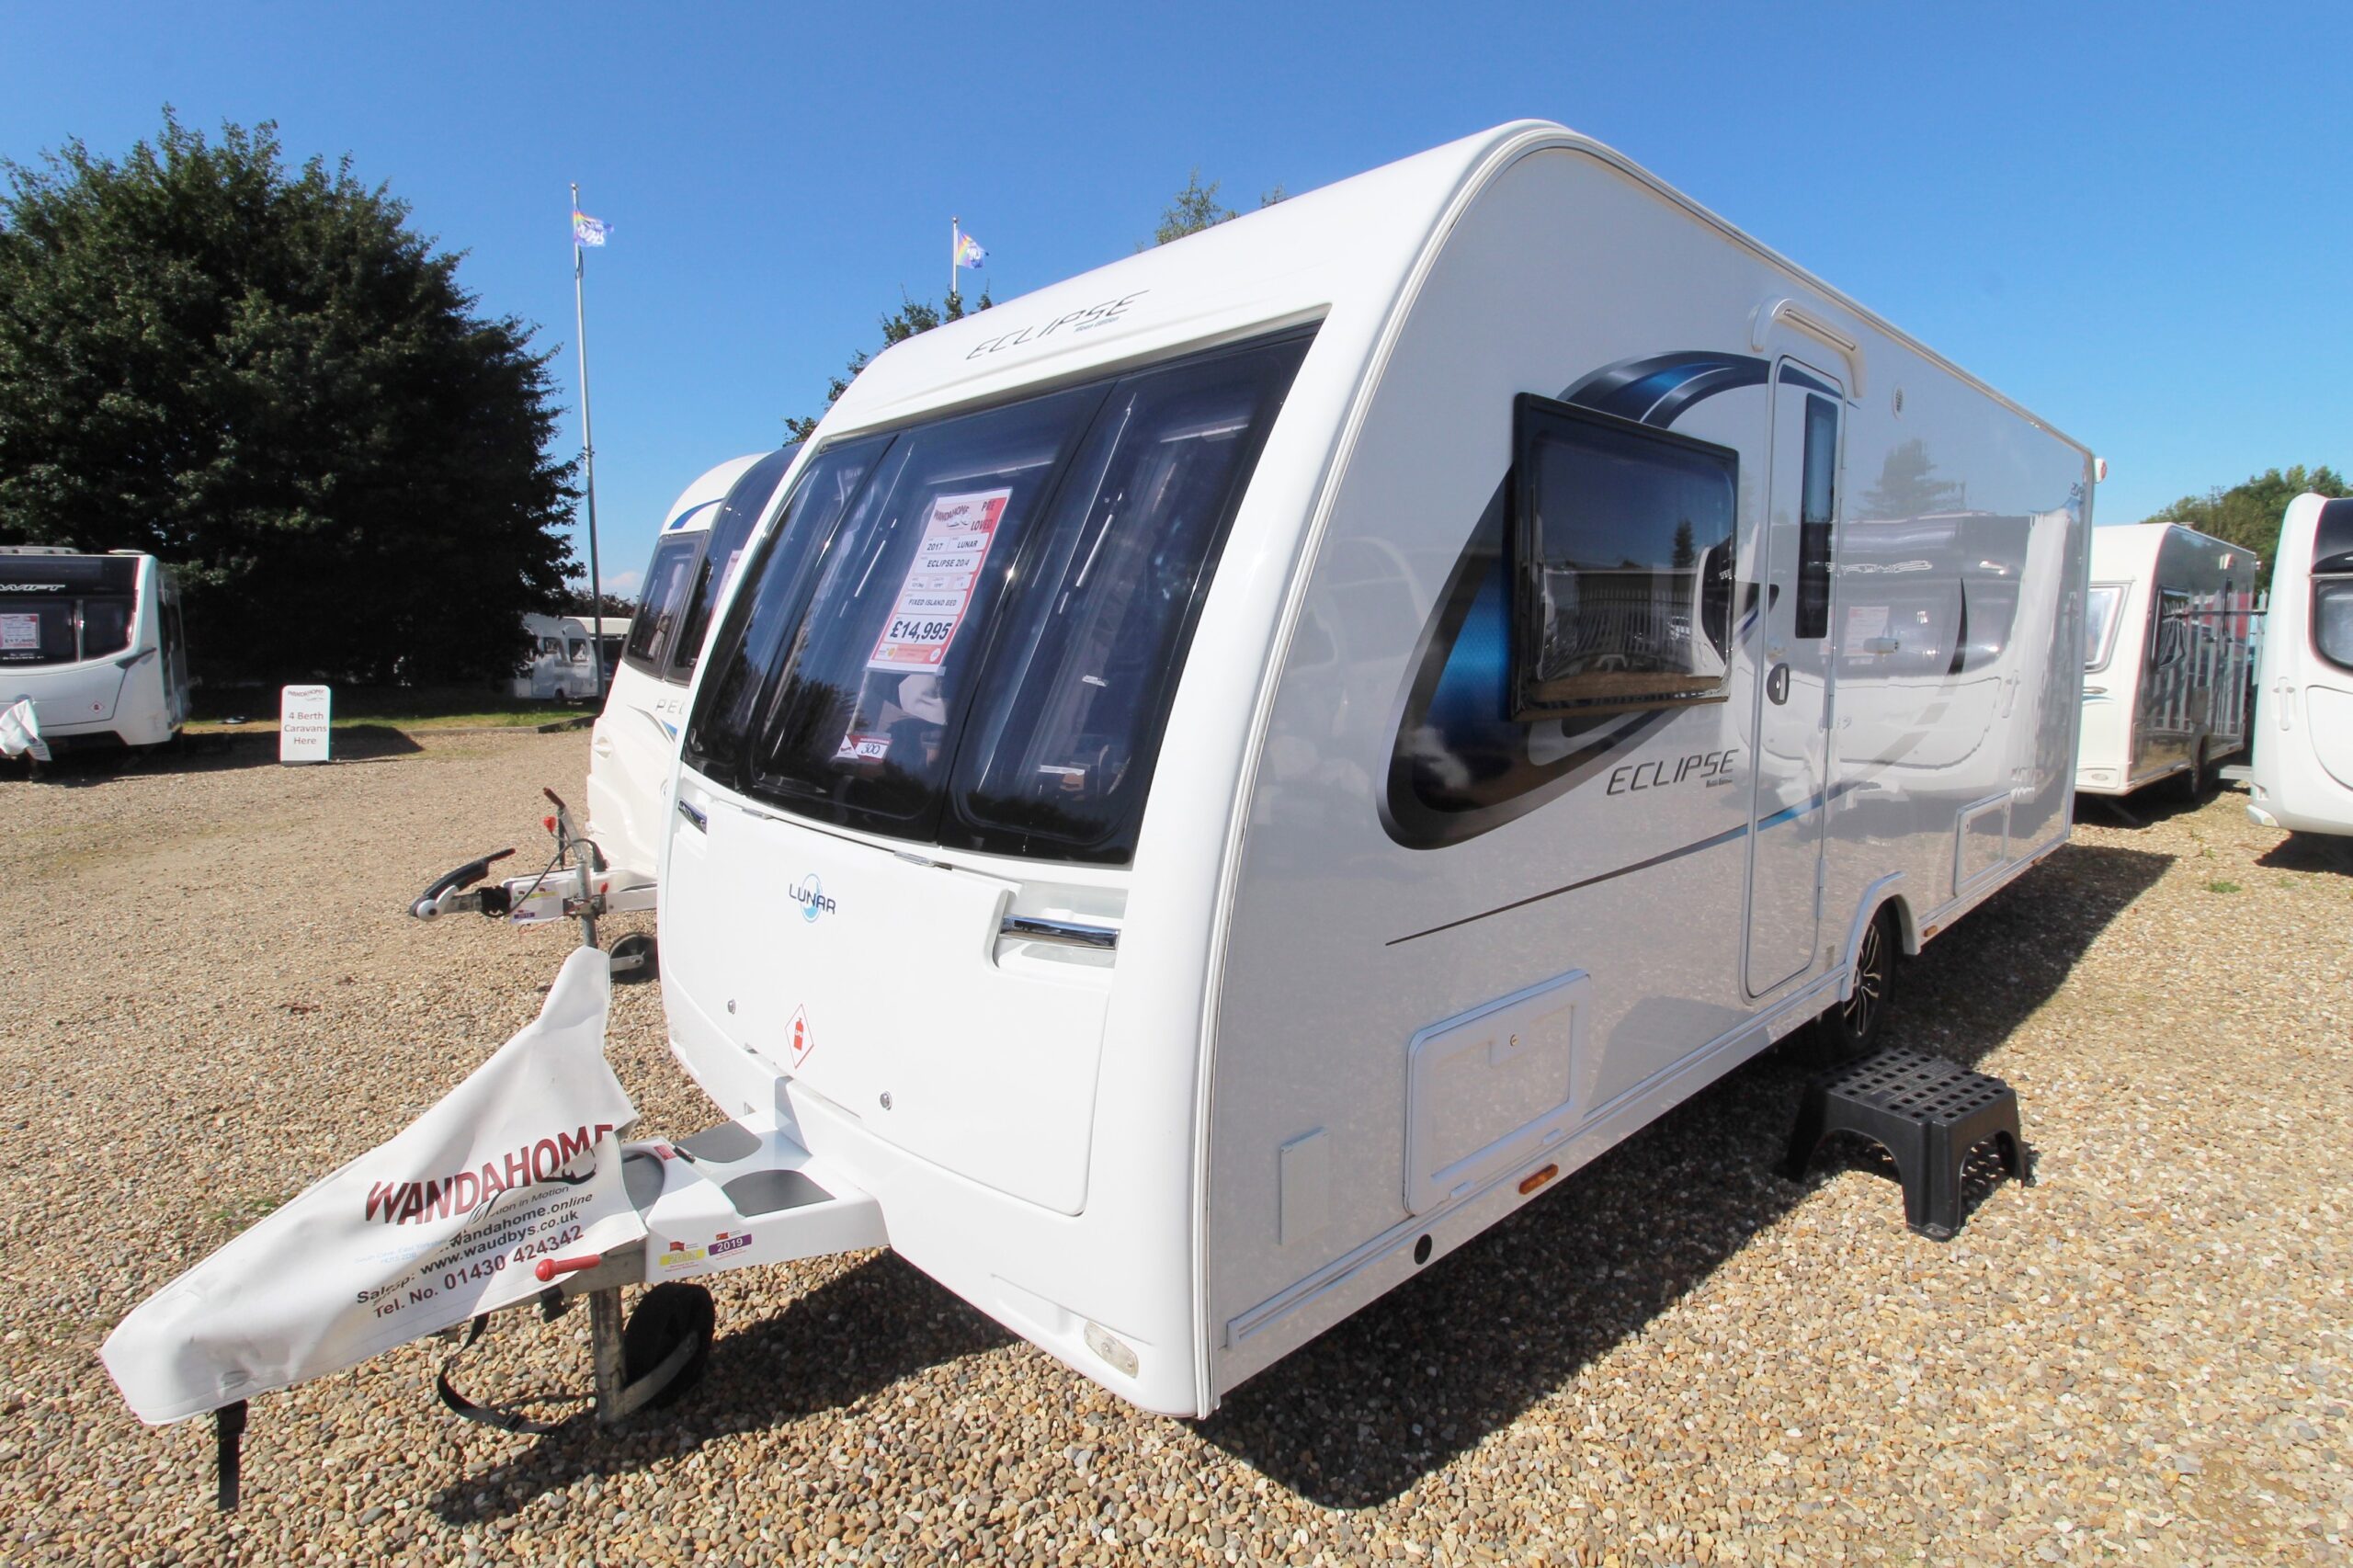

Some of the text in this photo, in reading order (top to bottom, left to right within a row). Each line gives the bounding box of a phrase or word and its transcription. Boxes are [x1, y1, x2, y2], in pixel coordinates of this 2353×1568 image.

[965, 289, 1151, 360] ECLIPSE
[971, 519, 994, 531] LOVED
[926, 542, 944, 551] 2017
[957, 540, 978, 549] LUNAR
[926, 559, 955, 567] ECLIPSE
[890, 621, 953, 643] £14,995
[298, 711, 324, 720] Berth
[284, 724, 327, 733] Caravans
[1607, 749, 1739, 796] ECLIPSE
[789, 883, 836, 915] LUNAR
[531, 1187, 569, 1202] Motion
[420, 1210, 579, 1275] www.waudbys.co.uk
[717, 1237, 744, 1252] 2019
[374, 1224, 584, 1318] Tel. No. 01430 424342
